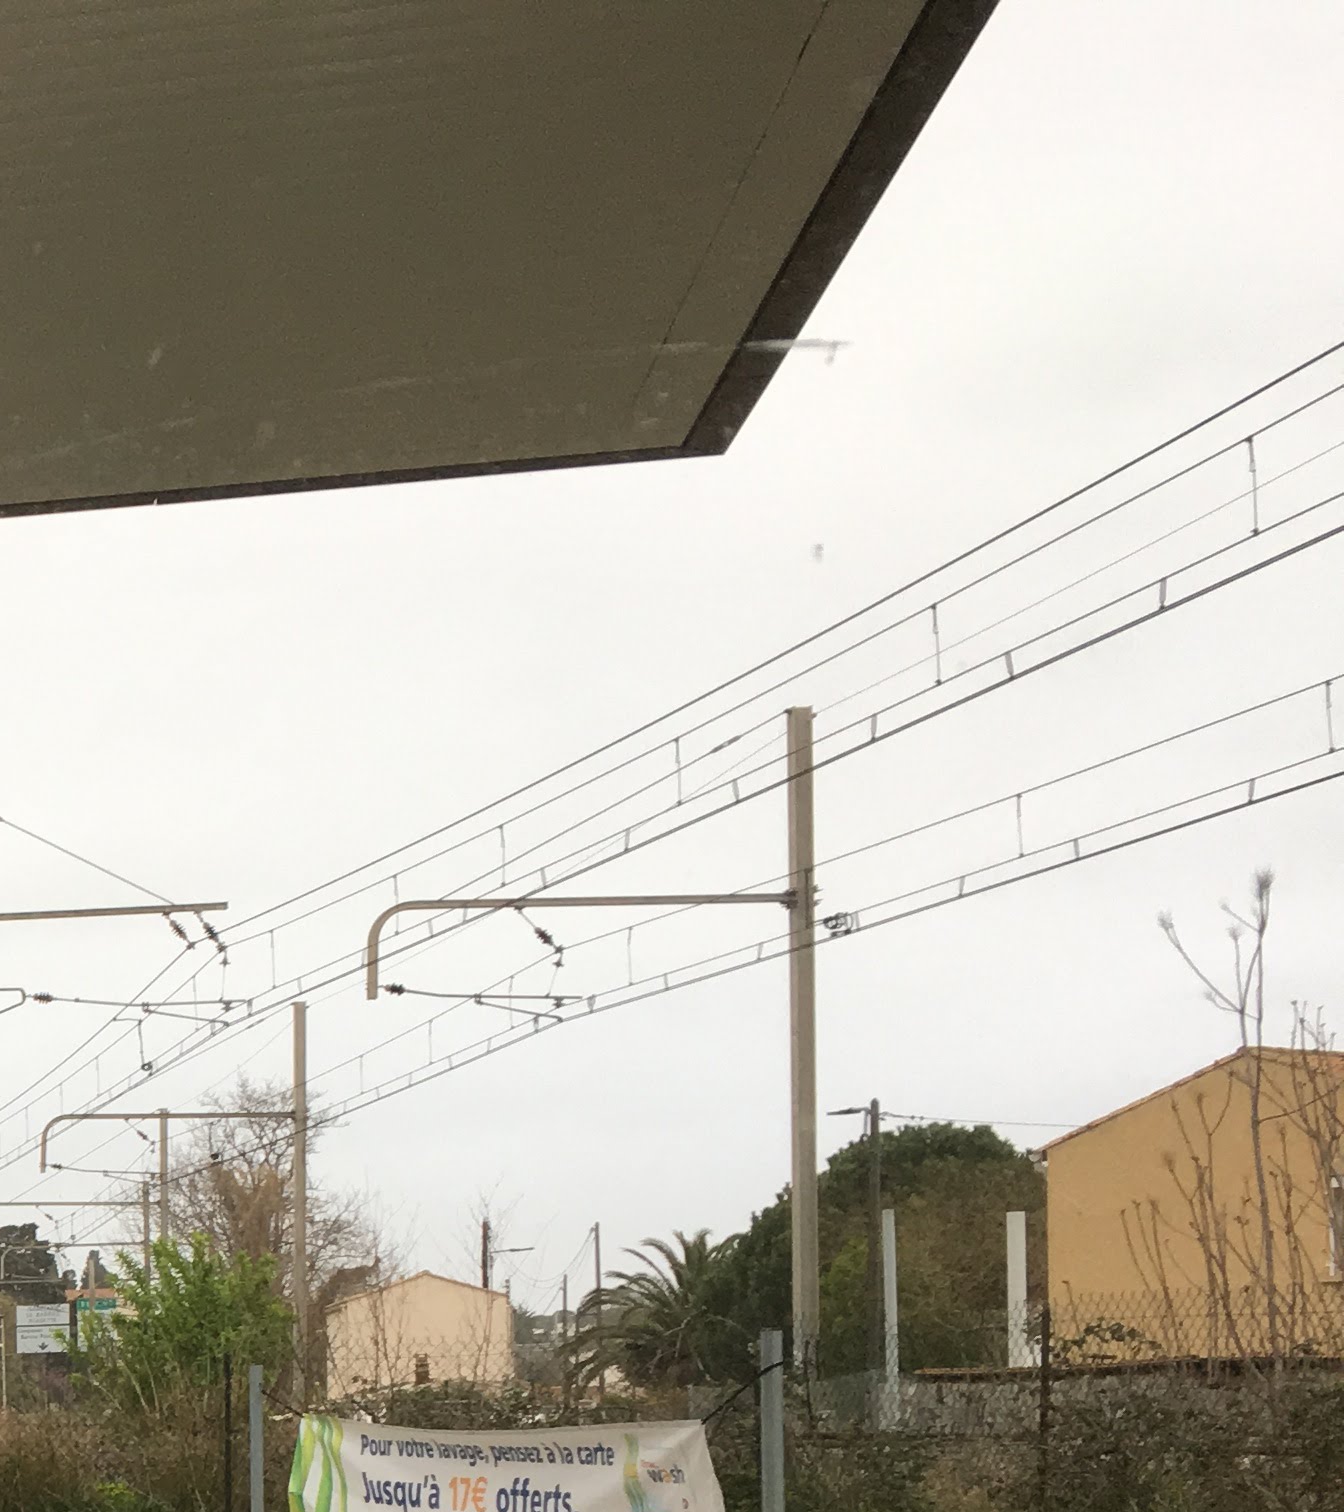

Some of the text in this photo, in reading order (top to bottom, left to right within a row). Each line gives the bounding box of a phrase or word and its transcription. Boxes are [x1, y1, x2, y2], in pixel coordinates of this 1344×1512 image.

[360, 1434, 615, 1468] Pour votre lavage, pensez à la carte
[647, 1464, 686, 1484] wash
